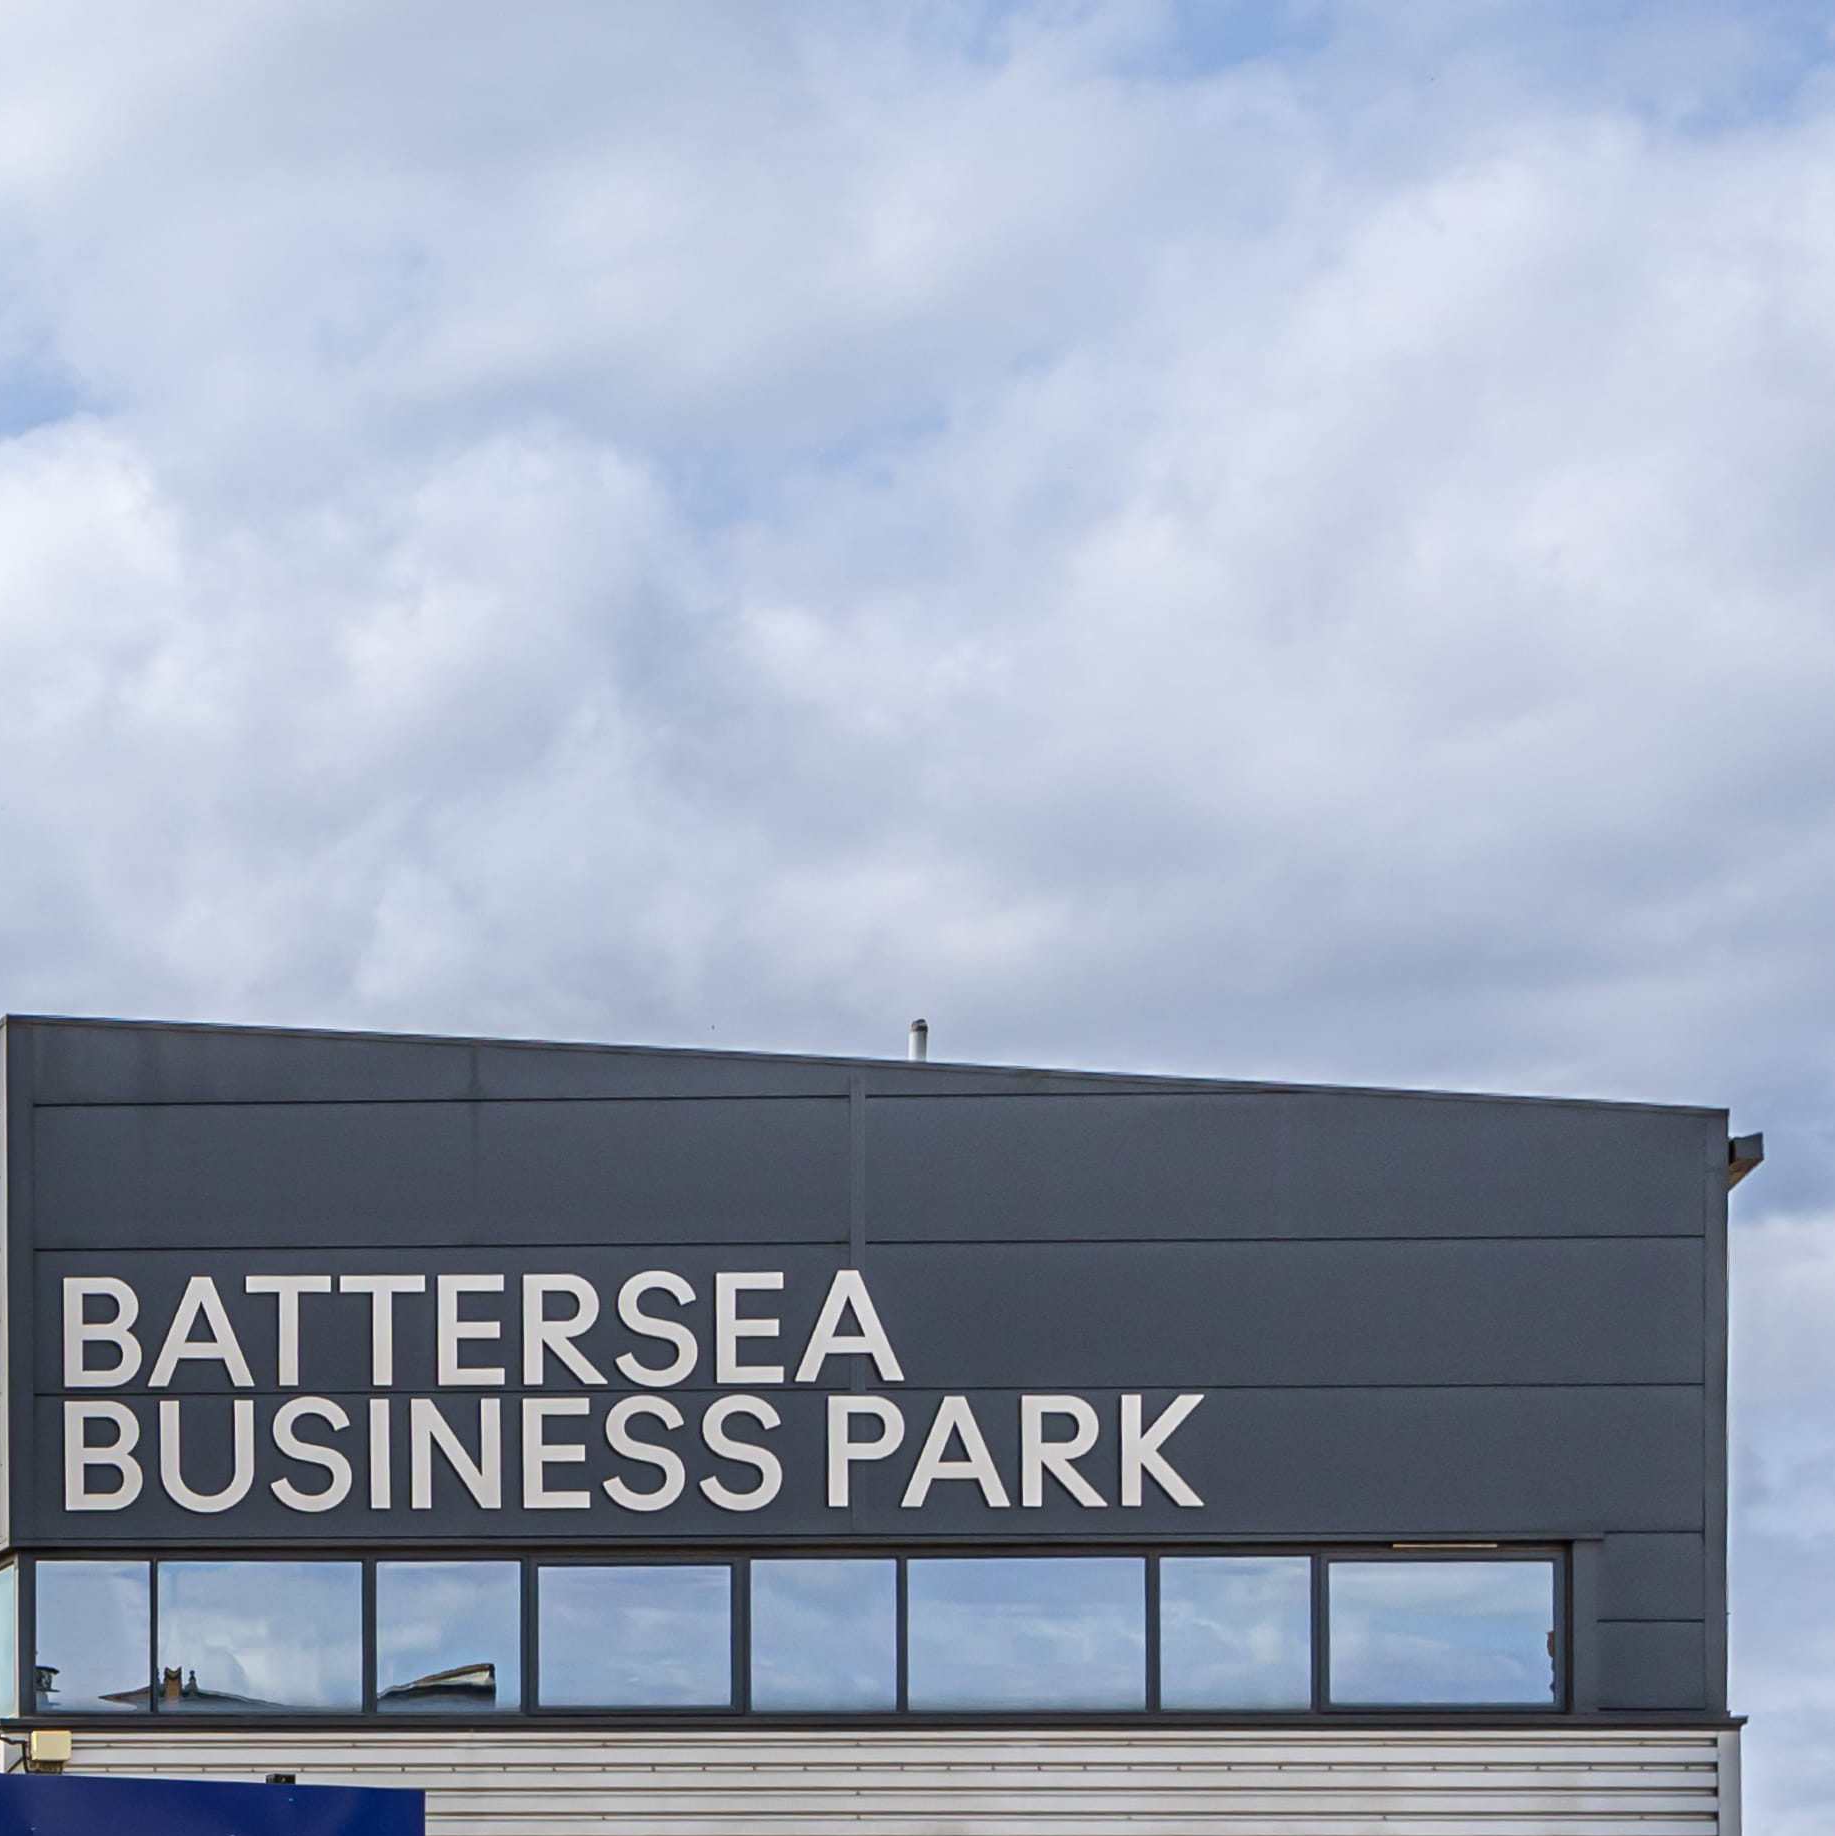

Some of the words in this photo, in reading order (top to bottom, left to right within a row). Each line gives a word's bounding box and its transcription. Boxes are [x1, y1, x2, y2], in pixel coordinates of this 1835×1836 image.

[63, 1269, 905, 1388] BATTERSEA
[63, 1393, 784, 1513] BUSINESS
[828, 1394, 1205, 1508] PARK
